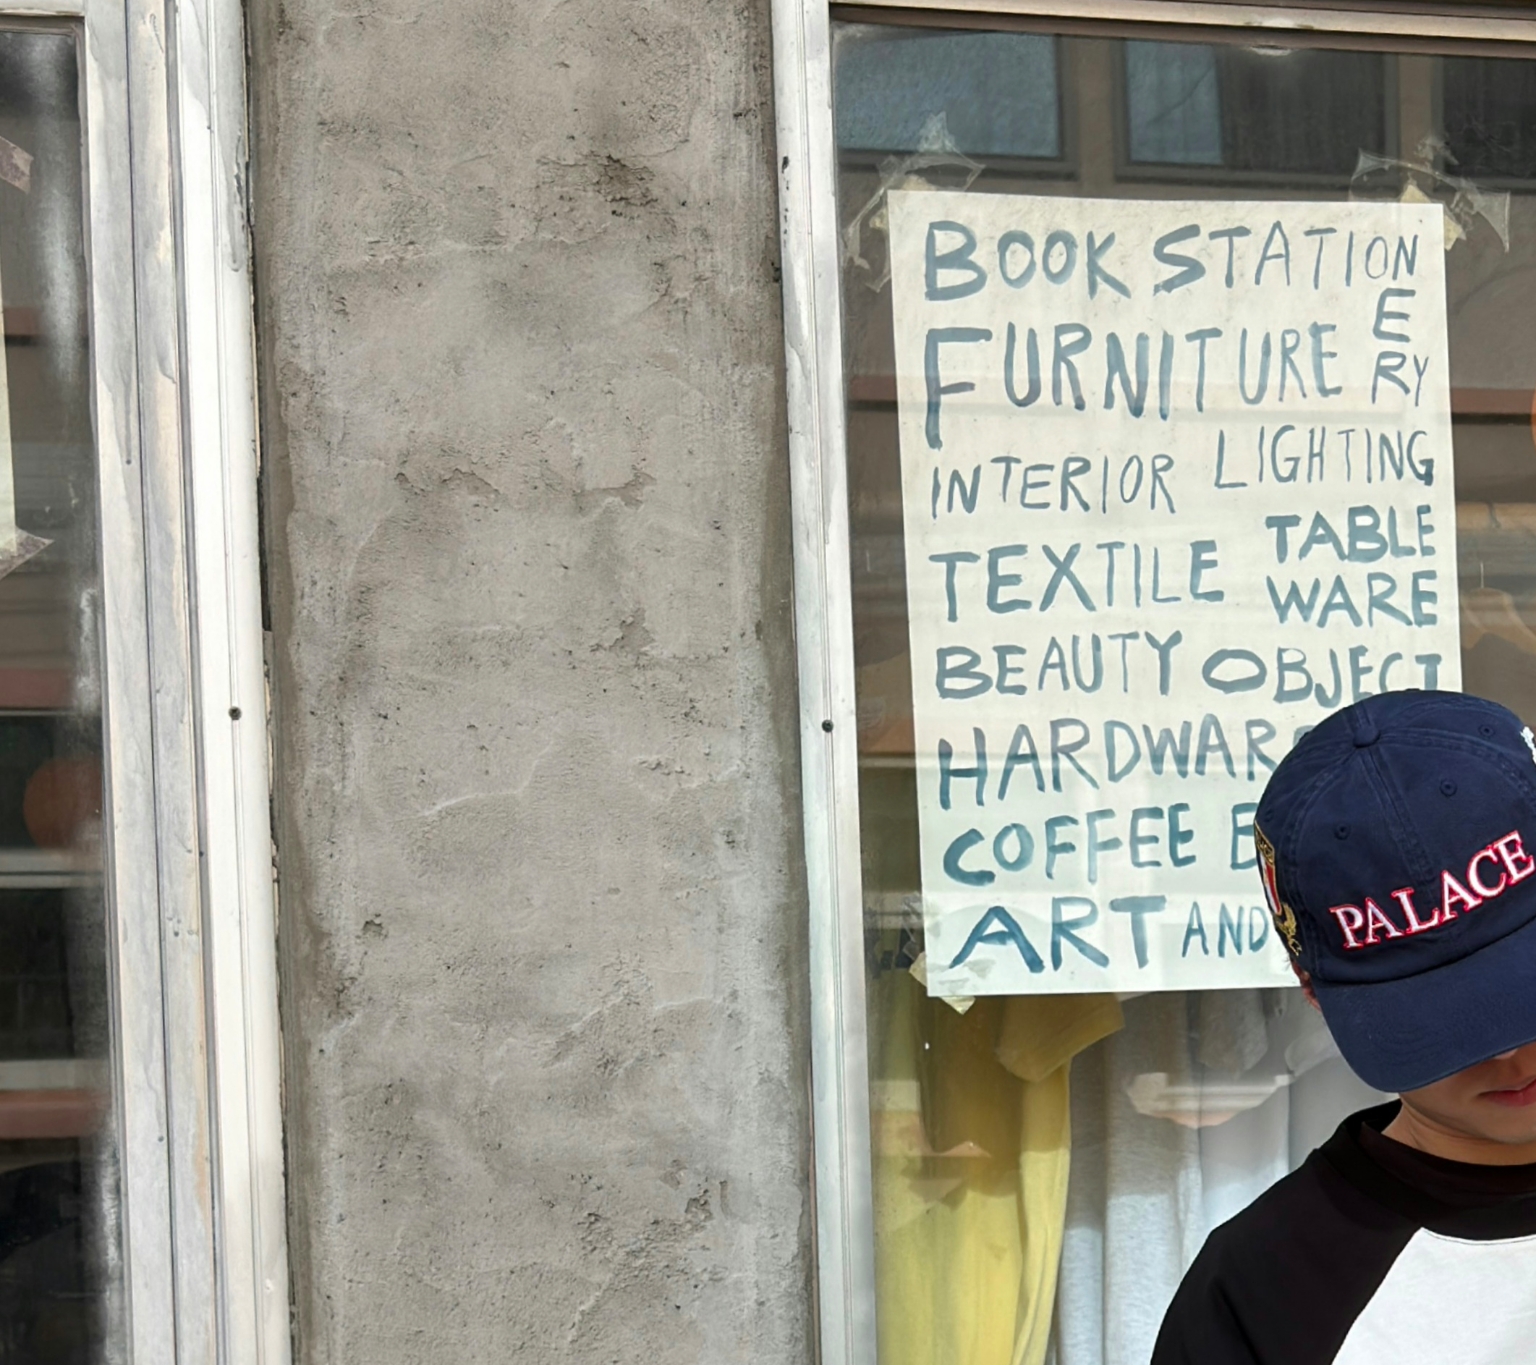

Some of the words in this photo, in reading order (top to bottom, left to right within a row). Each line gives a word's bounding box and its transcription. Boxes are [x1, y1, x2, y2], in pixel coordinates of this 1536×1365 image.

[924, 220, 1131, 301] BOOK
[1153, 220, 1419, 290] STATION
[924, 321, 1343, 450] FURNITURE
[931, 454, 1176, 519] INTERIOR
[1214, 424, 1434, 489] LIGHTING
[1265, 504, 1436, 563] TABLE
[929, 540, 1225, 622] TEXTILE
[1266, 570, 1438, 627] WARE
[935, 630, 1183, 699] BEAUTY
[1202, 645, 1442, 708] OBJECT
[939, 713, 1314, 810] HARDWAR
[943, 802, 1197, 886] COFFEE
[1329, 830, 1536, 950] PALACE
[949, 896, 1167, 973] ART
[1182, 901, 1268, 957] AND
